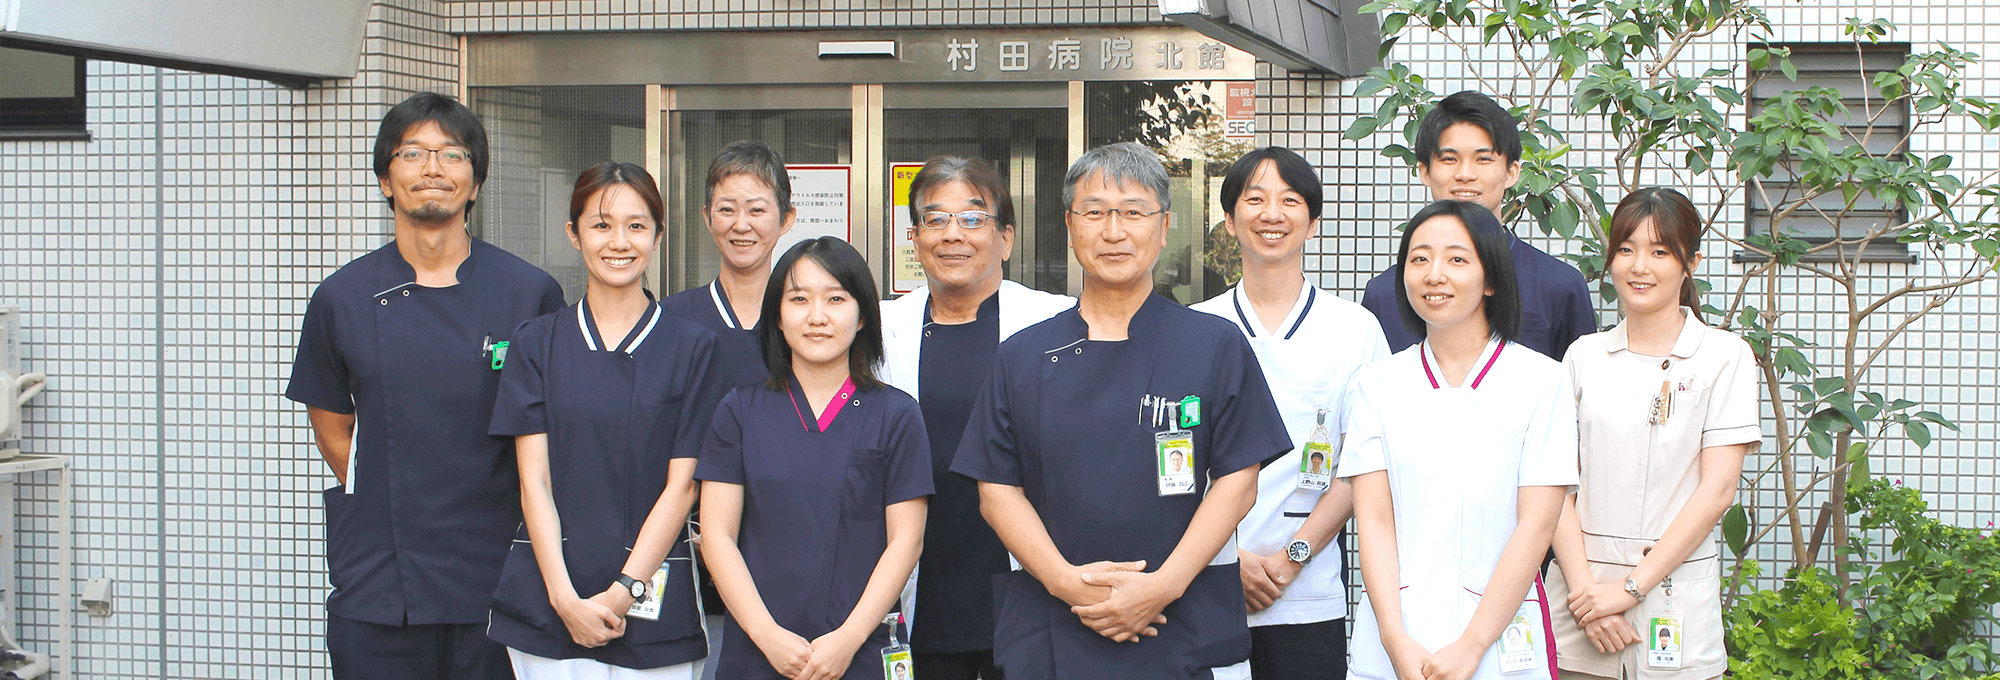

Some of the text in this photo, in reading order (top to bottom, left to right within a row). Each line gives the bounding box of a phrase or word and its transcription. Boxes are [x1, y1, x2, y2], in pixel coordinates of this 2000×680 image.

[947, 37, 1226, 71] 村田病院北館
[1228, 121, 1255, 134] SEC
